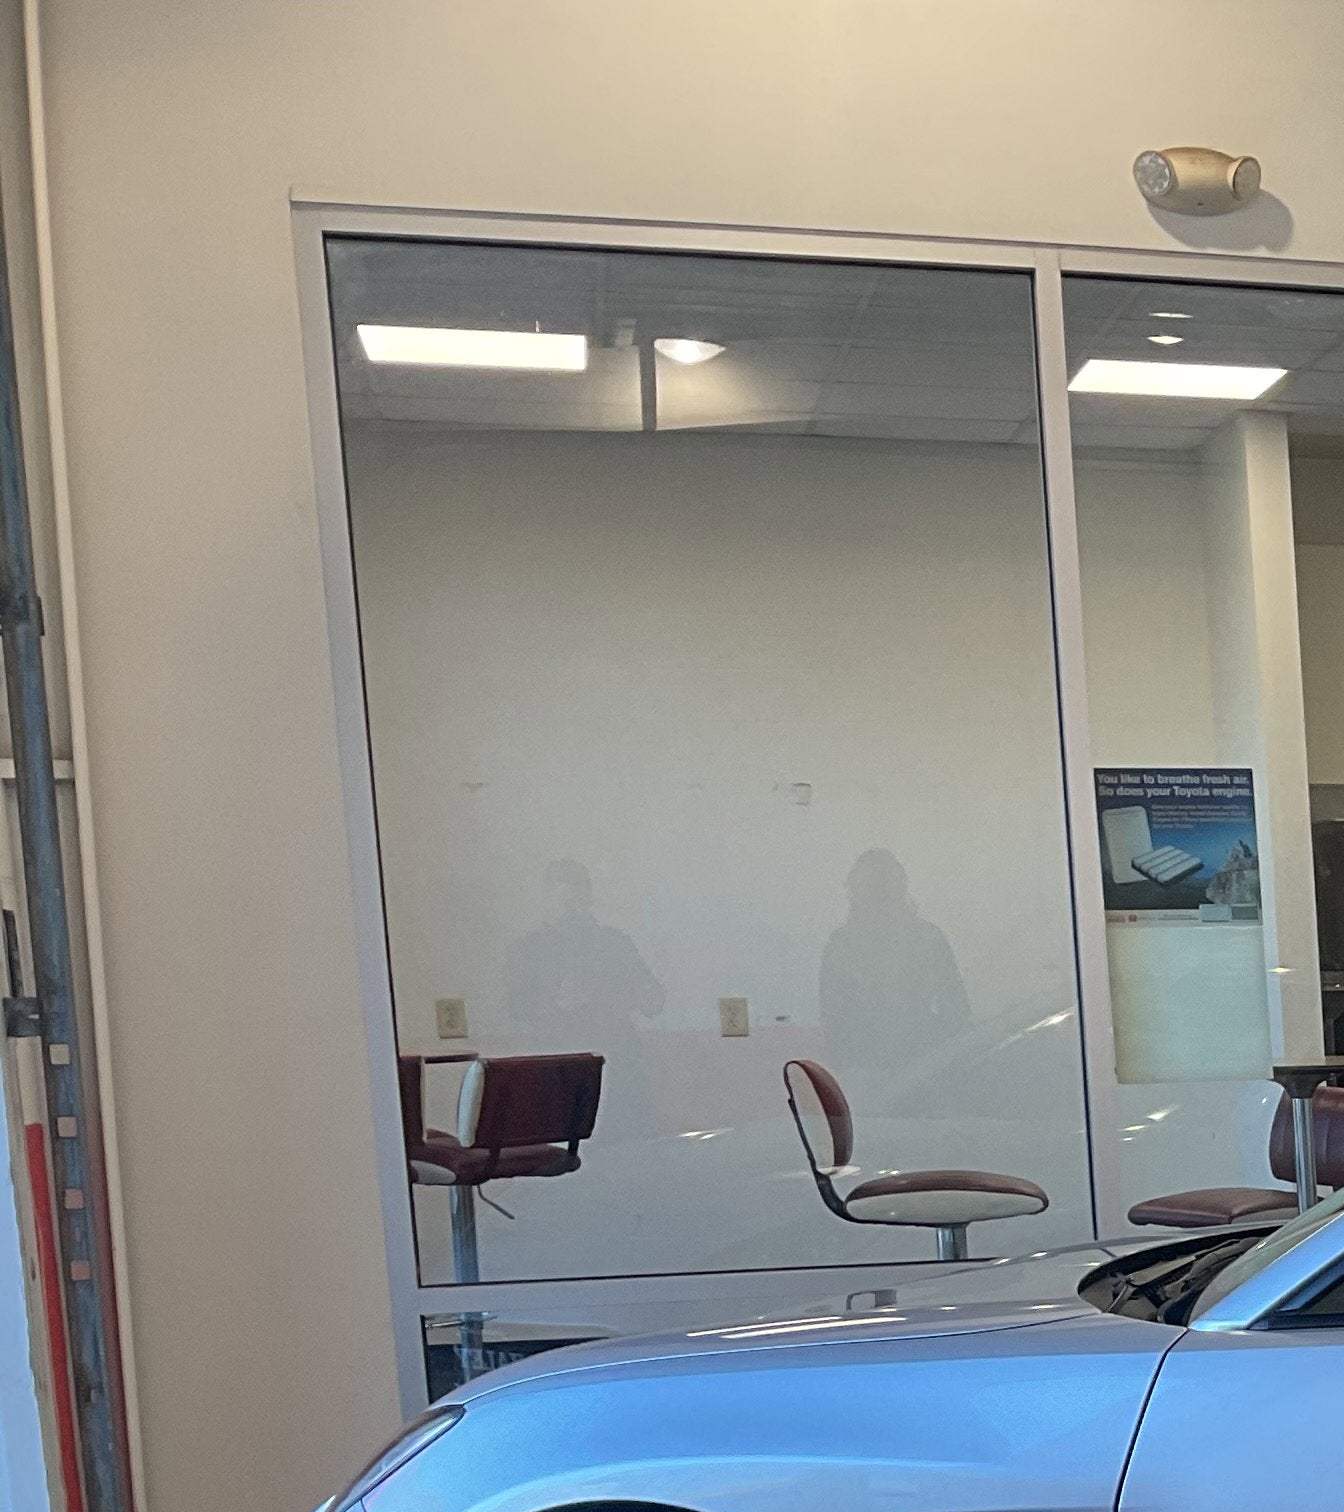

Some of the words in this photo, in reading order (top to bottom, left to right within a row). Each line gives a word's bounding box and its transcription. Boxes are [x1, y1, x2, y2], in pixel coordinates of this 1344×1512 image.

[1096, 774, 1118, 784] You
[1120, 774, 1141, 784] like
[1144, 775, 1155, 784] to
[1157, 774, 1200, 784] breathe
[1202, 774, 1231, 784] fresh
[1098, 786, 1114, 796] So
[1116, 786, 1144, 796] does
[1147, 788, 1171, 798] your
[1173, 786, 1210, 798] Toyota
[1212, 787, 1252, 798] engine.
